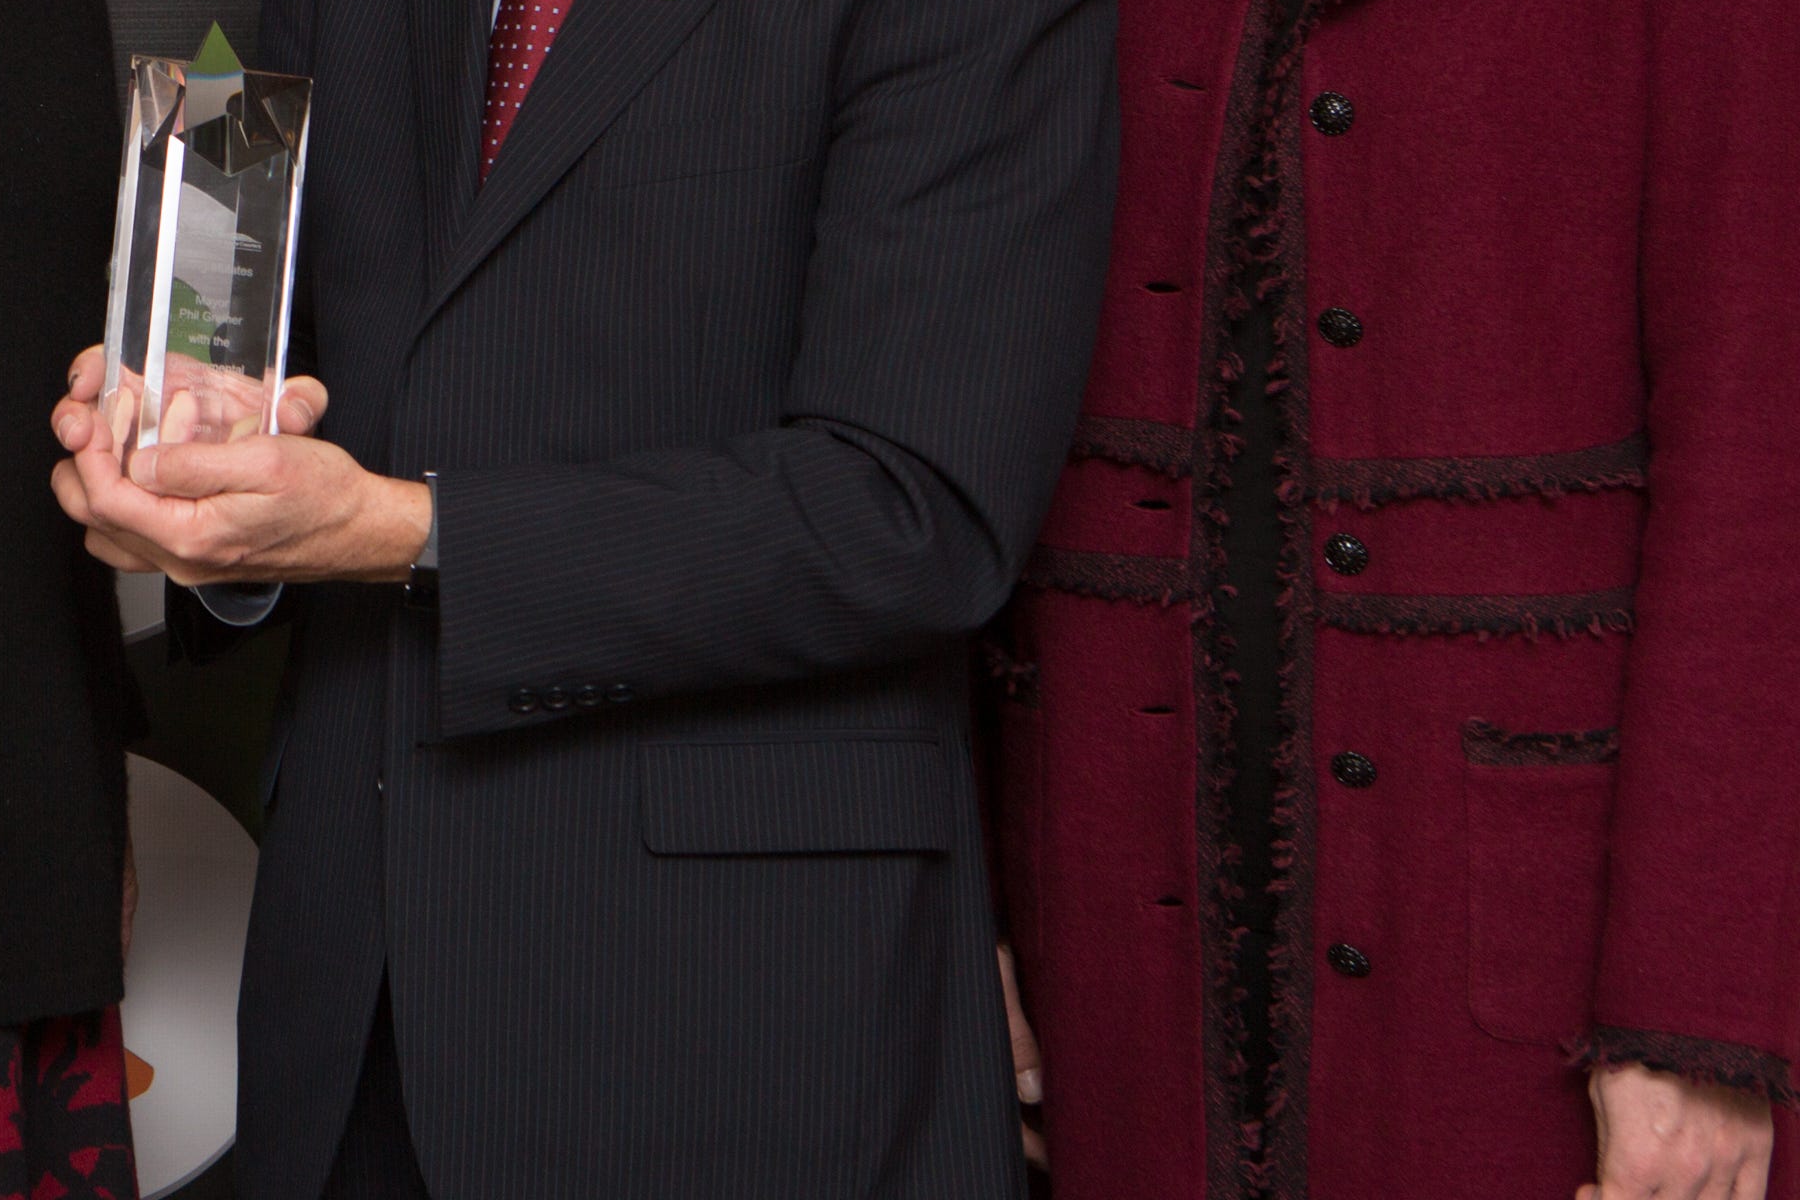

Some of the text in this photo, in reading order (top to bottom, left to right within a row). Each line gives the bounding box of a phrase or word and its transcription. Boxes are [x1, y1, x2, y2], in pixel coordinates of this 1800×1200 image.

[179, 307, 200, 321] Phil
[188, 333, 231, 348] with the
